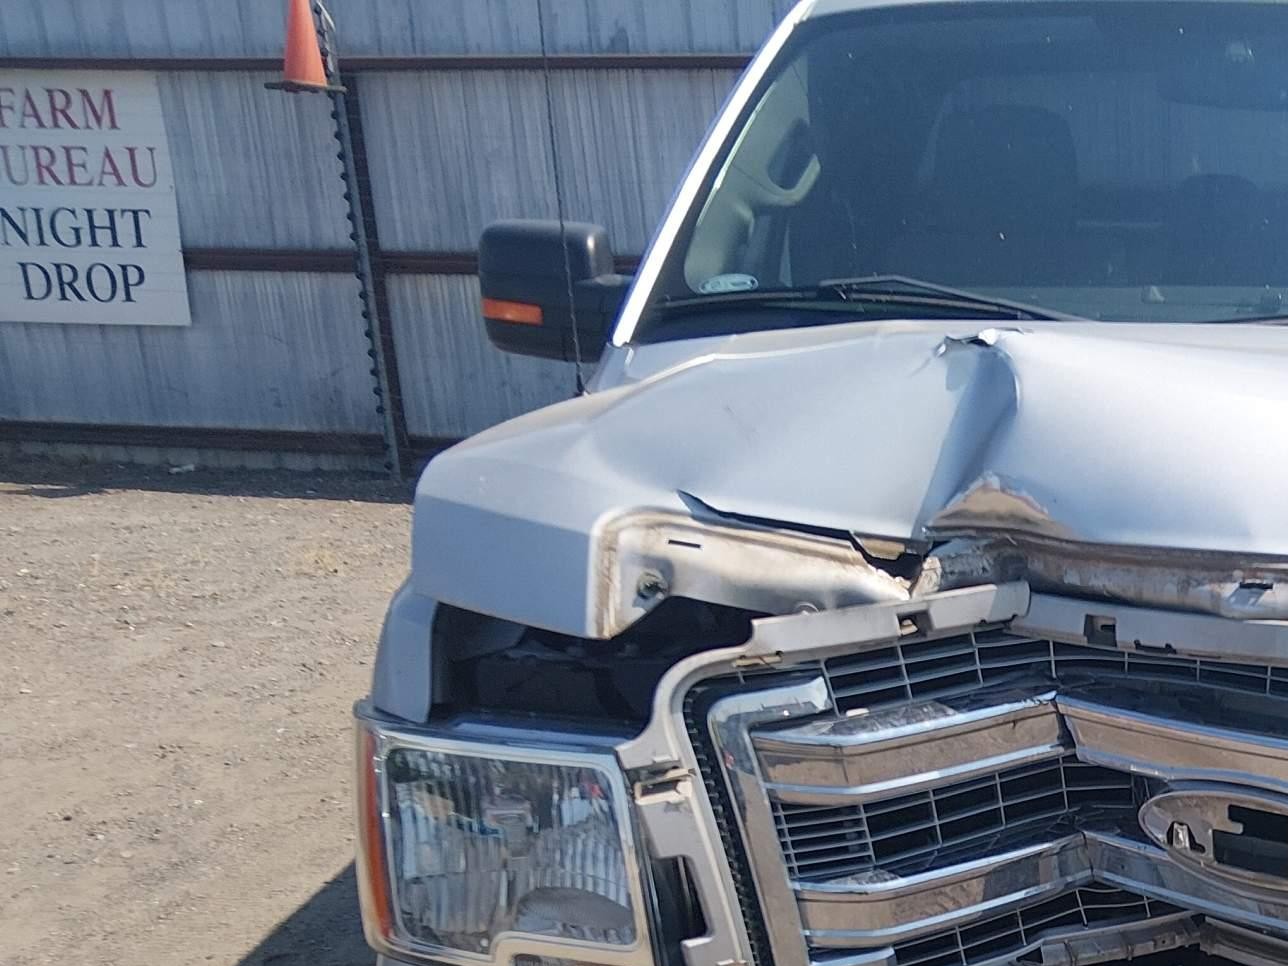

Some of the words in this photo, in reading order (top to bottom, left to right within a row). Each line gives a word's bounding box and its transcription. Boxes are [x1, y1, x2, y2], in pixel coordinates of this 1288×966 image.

[0, 88, 120, 130] FARM
[0, 145, 157, 188] UREAU
[0, 207, 152, 248] NIGHT
[17, 262, 145, 303] DROP
